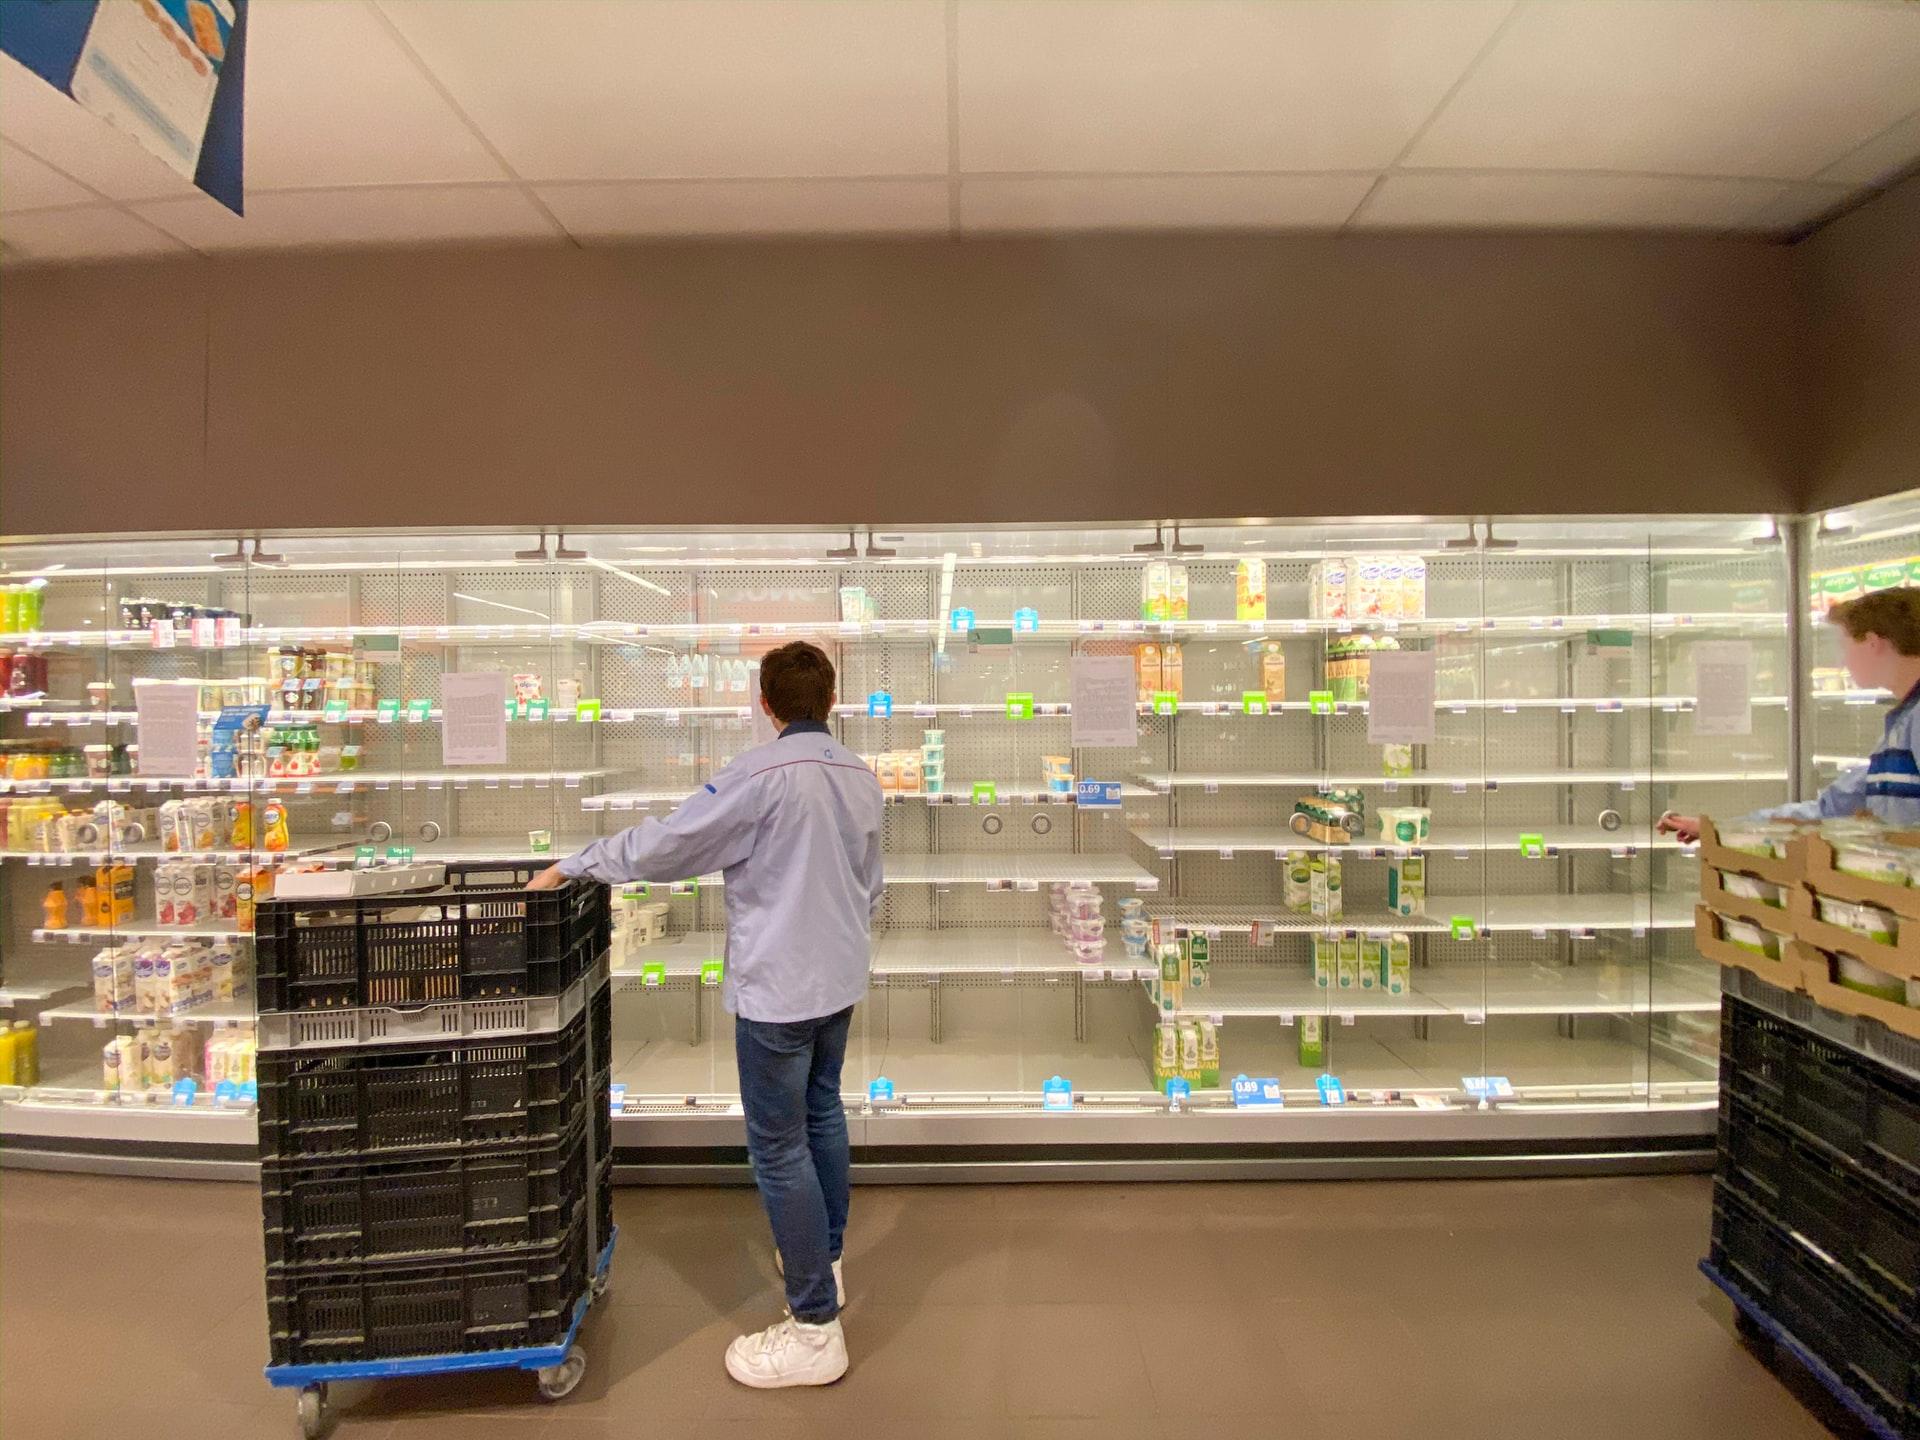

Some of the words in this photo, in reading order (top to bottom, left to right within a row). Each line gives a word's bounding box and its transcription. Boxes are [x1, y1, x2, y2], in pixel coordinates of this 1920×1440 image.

[1079, 784, 1100, 794] 0.69
[1200, 1061, 1217, 1069] VAN
[1160, 1068, 1178, 1077] VAN
[1181, 1070, 1200, 1080] VAN
[1235, 1081, 1258, 1093] 0.89
